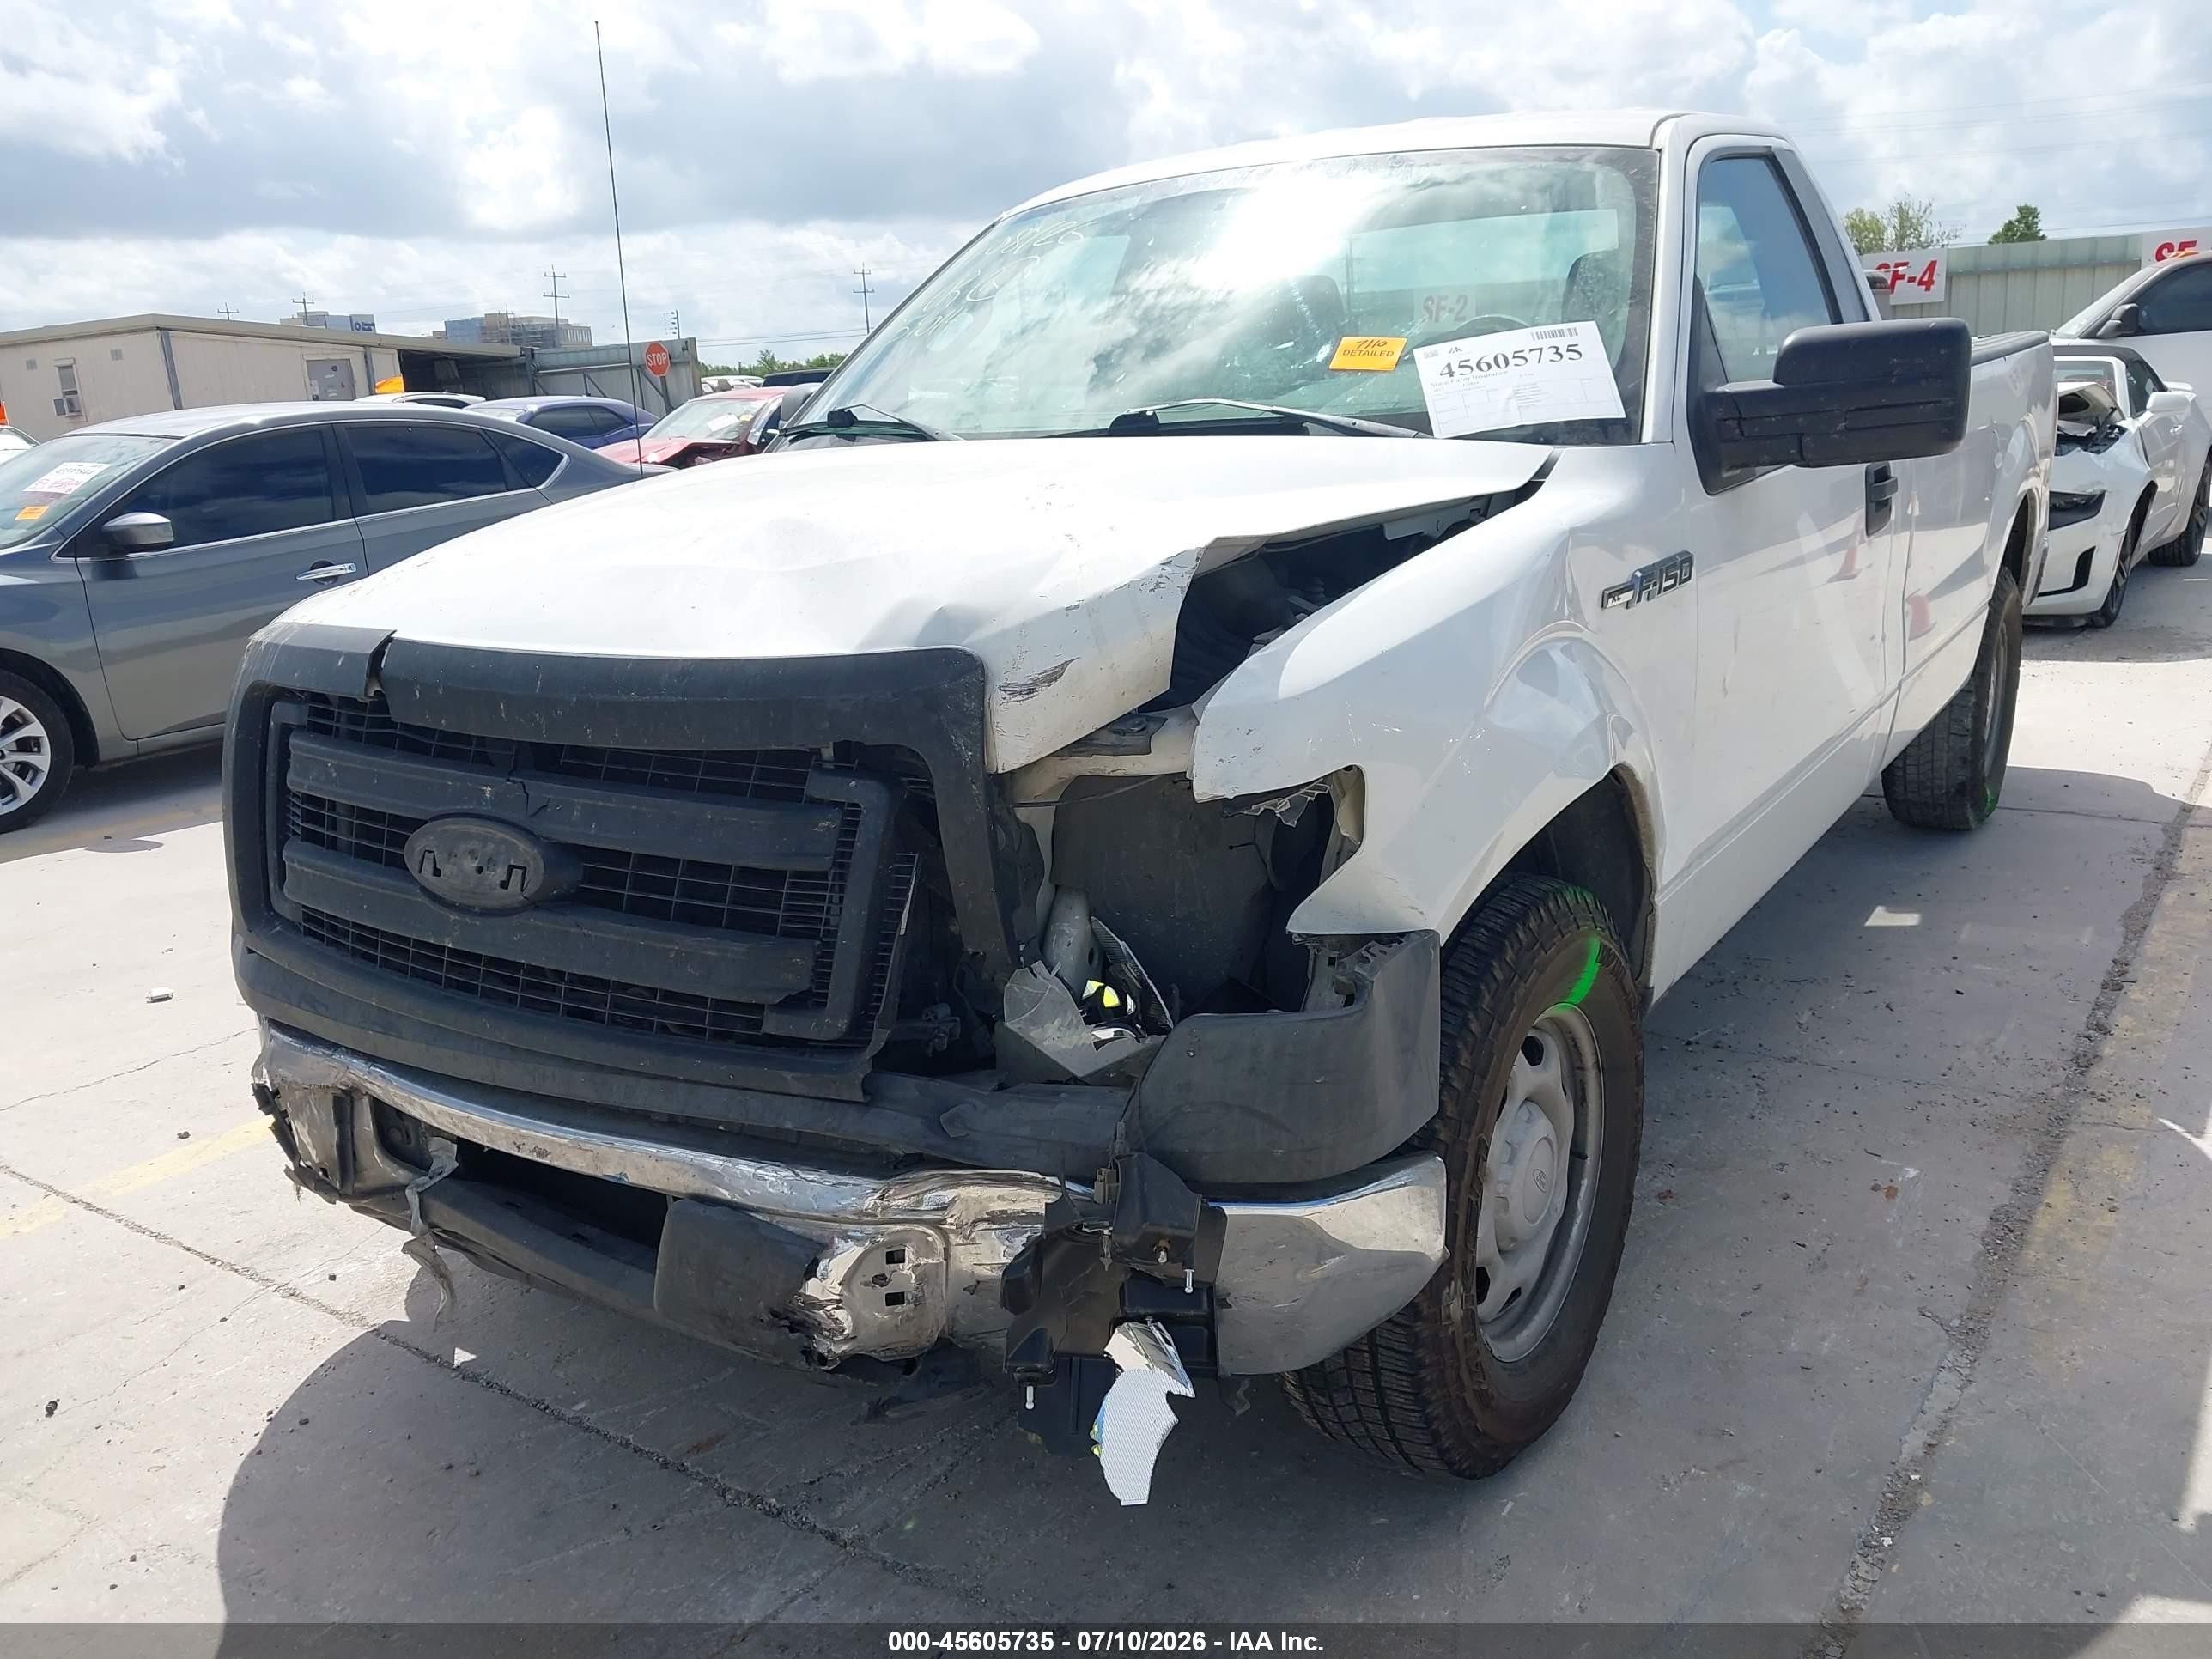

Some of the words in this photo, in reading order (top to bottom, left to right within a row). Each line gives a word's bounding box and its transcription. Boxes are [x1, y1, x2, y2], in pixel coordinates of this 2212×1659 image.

[1422, 294, 1468, 324] SF-2
[647, 352, 667, 367] STOP
[1342, 349, 1395, 357] DETAILED
[1439, 343, 1583, 378] 45605735
